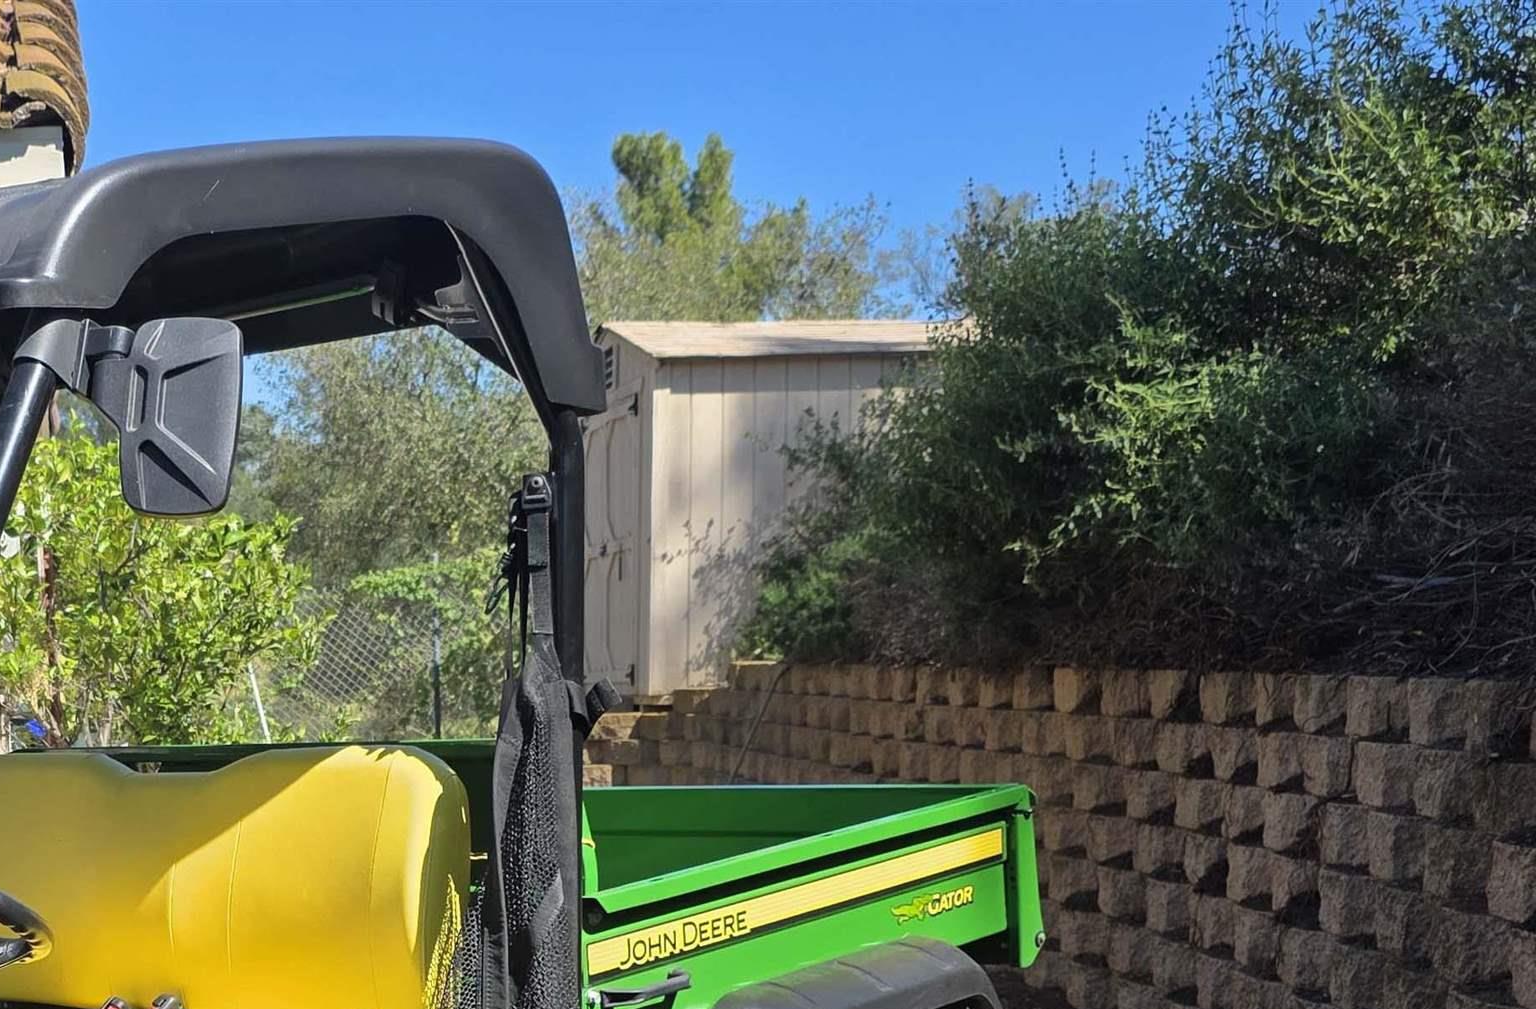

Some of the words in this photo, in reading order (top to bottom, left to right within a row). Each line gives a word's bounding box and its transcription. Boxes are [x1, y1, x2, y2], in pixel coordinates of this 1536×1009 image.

[928, 886, 974, 916] GATOR
[619, 929, 678, 967] JOHN
[682, 910, 749, 947] DEERE
